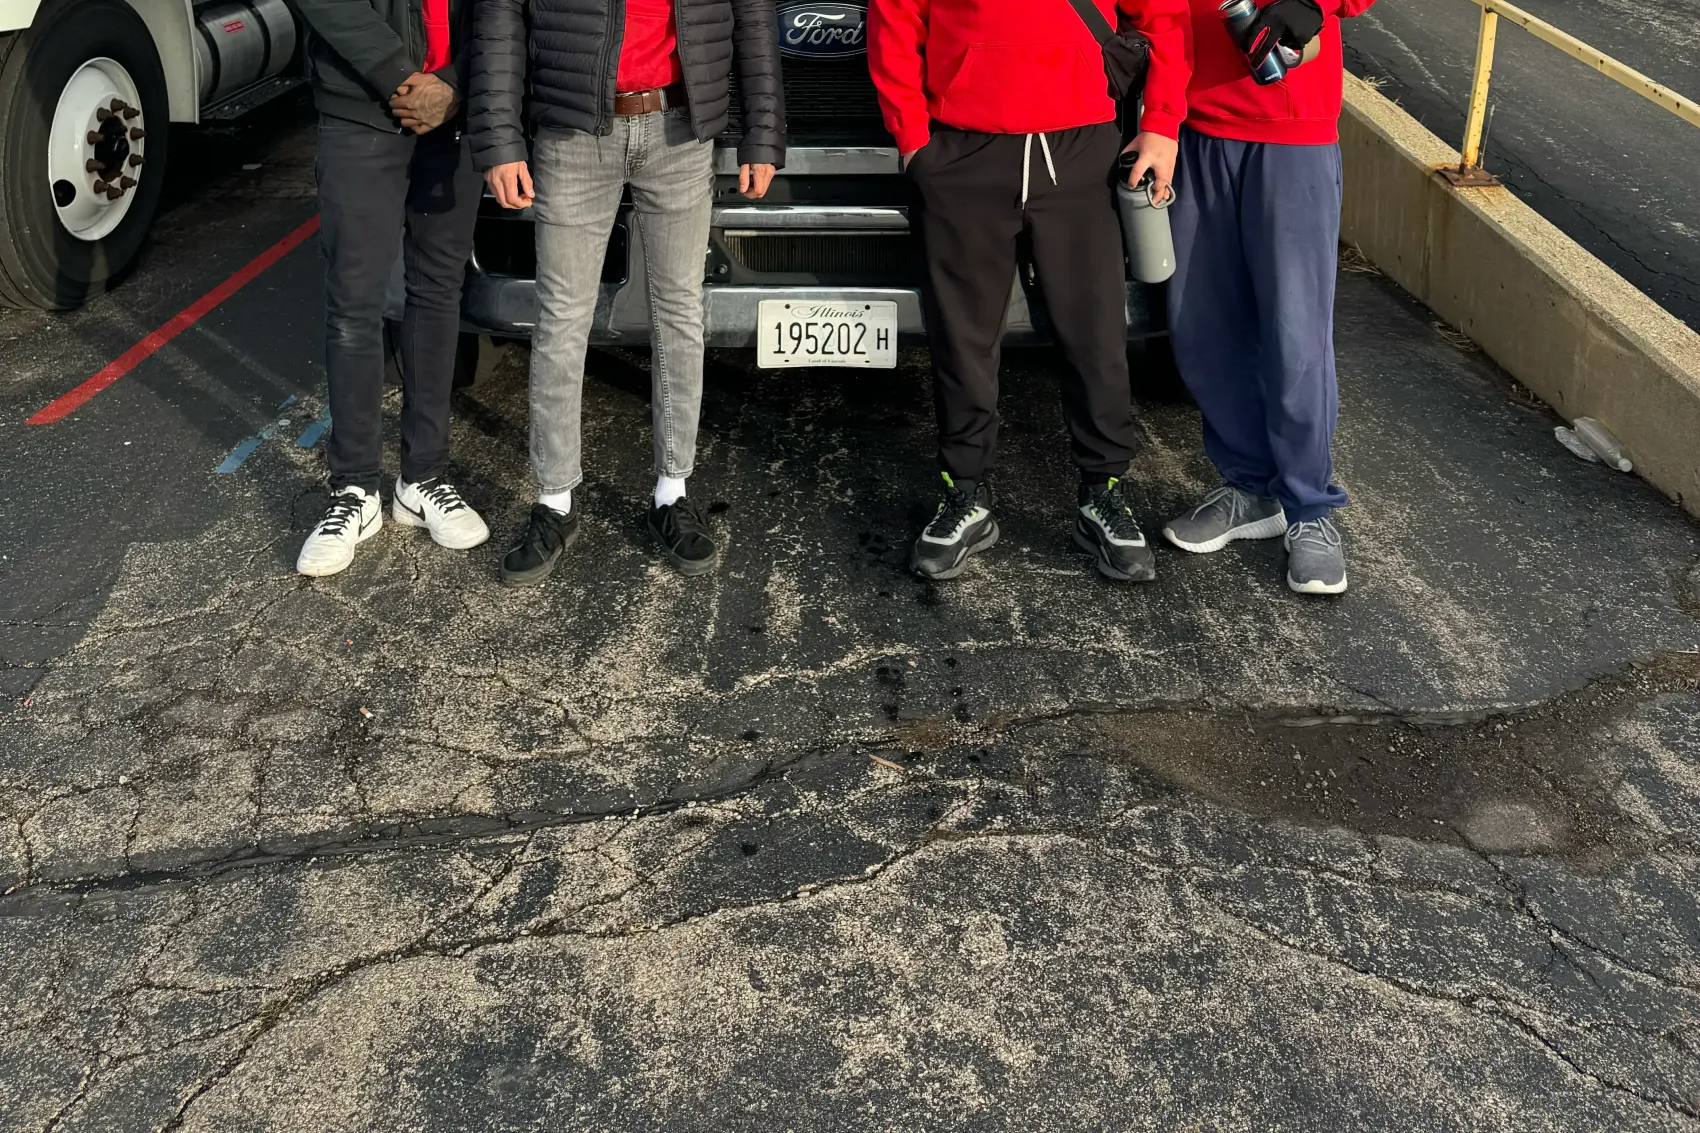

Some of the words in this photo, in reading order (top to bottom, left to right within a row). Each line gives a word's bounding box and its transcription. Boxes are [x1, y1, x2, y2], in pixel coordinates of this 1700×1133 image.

[786, 12, 865, 45] Ford
[791, 306, 864, 319] Illinois
[773, 322, 867, 355] 195202
[876, 327, 889, 350] H
